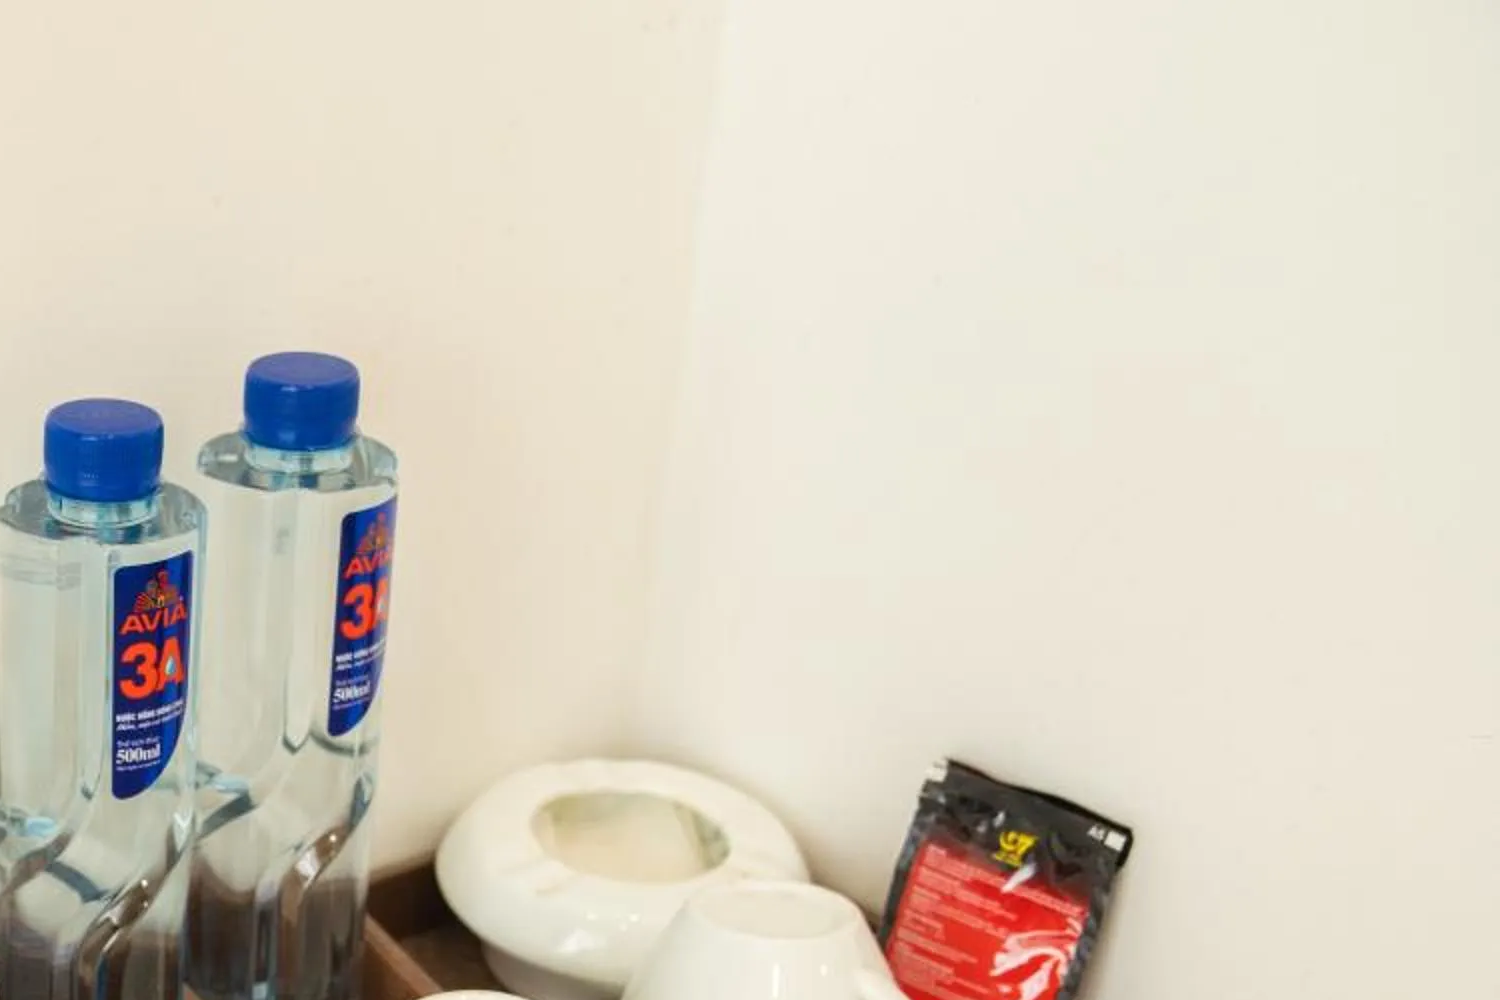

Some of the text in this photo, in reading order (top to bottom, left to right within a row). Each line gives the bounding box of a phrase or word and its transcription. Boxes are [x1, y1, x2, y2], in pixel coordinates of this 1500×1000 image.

[119, 602, 188, 635] AVIA
[119, 635, 185, 700] 3A
[115, 743, 161, 765] 500ml
